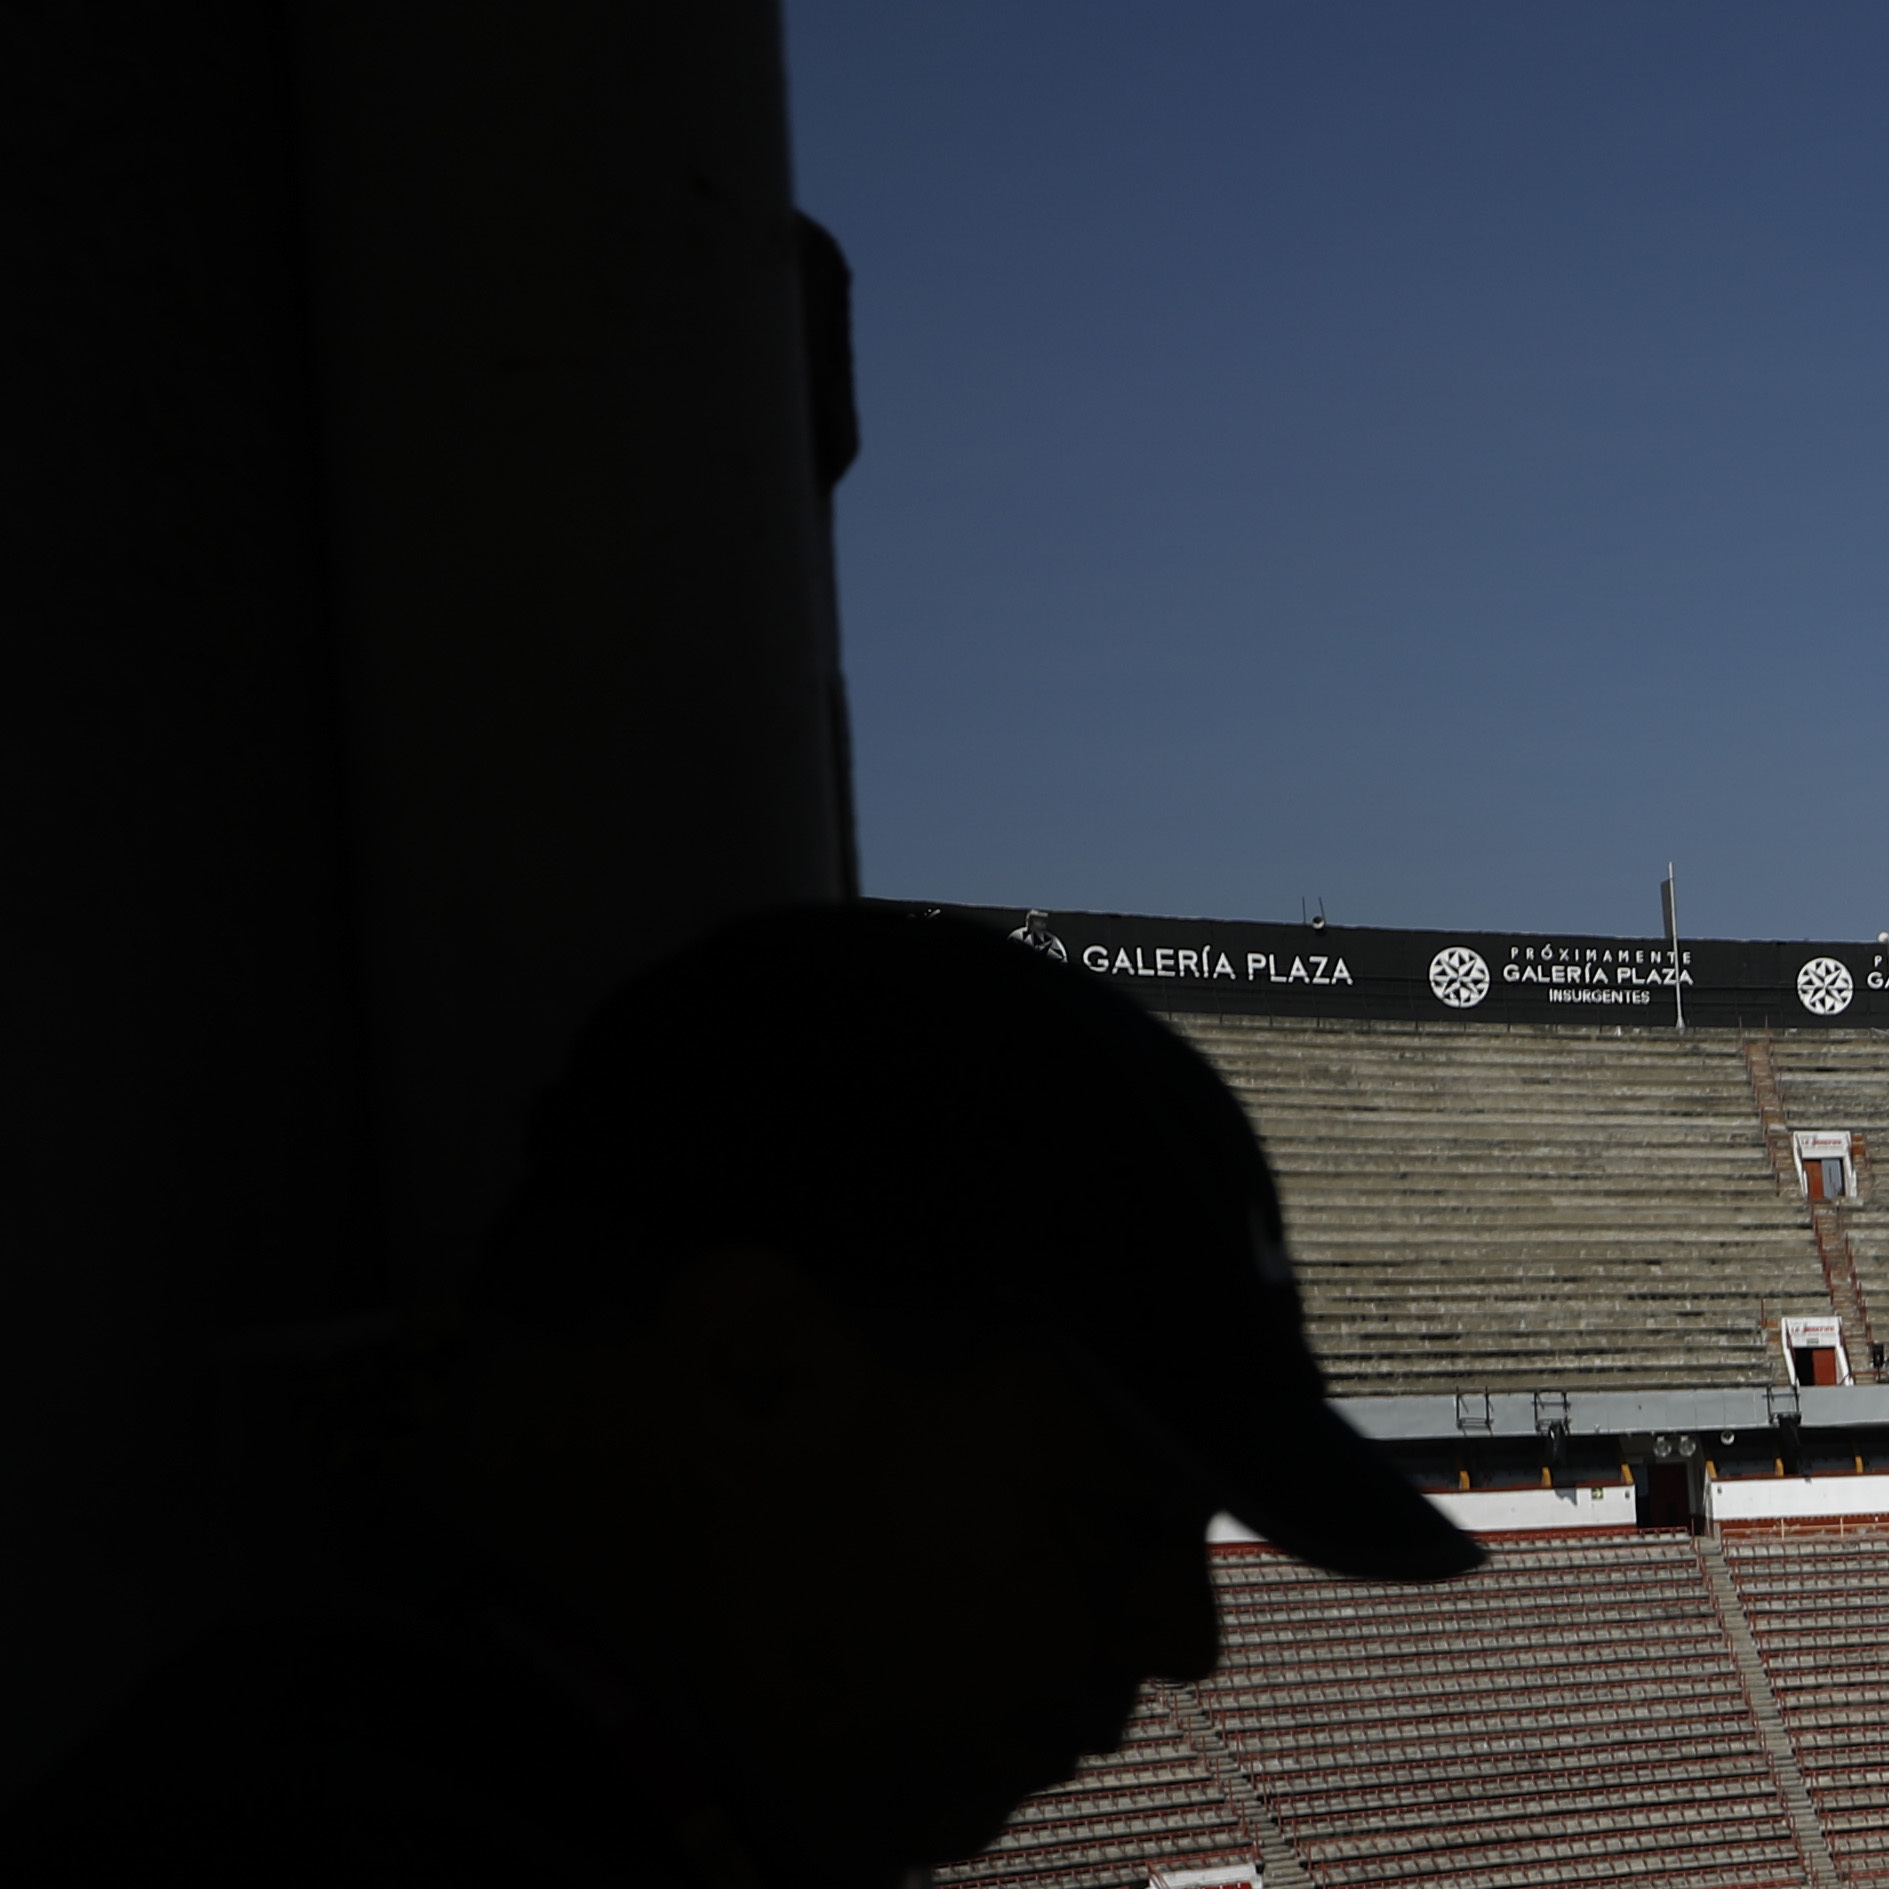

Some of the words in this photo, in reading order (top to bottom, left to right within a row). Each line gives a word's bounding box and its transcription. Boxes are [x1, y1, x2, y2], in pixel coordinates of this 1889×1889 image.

[1083, 944, 1237, 981] GALERÍA
[1247, 951, 1355, 986] PLAZA
[1510, 943, 1691, 965] PRÓXIMAMENTE
[1502, 962, 1608, 985] GALERÍA
[1616, 965, 1694, 987] PLAZA
[1548, 988, 1650, 1005] INSURGENTES
